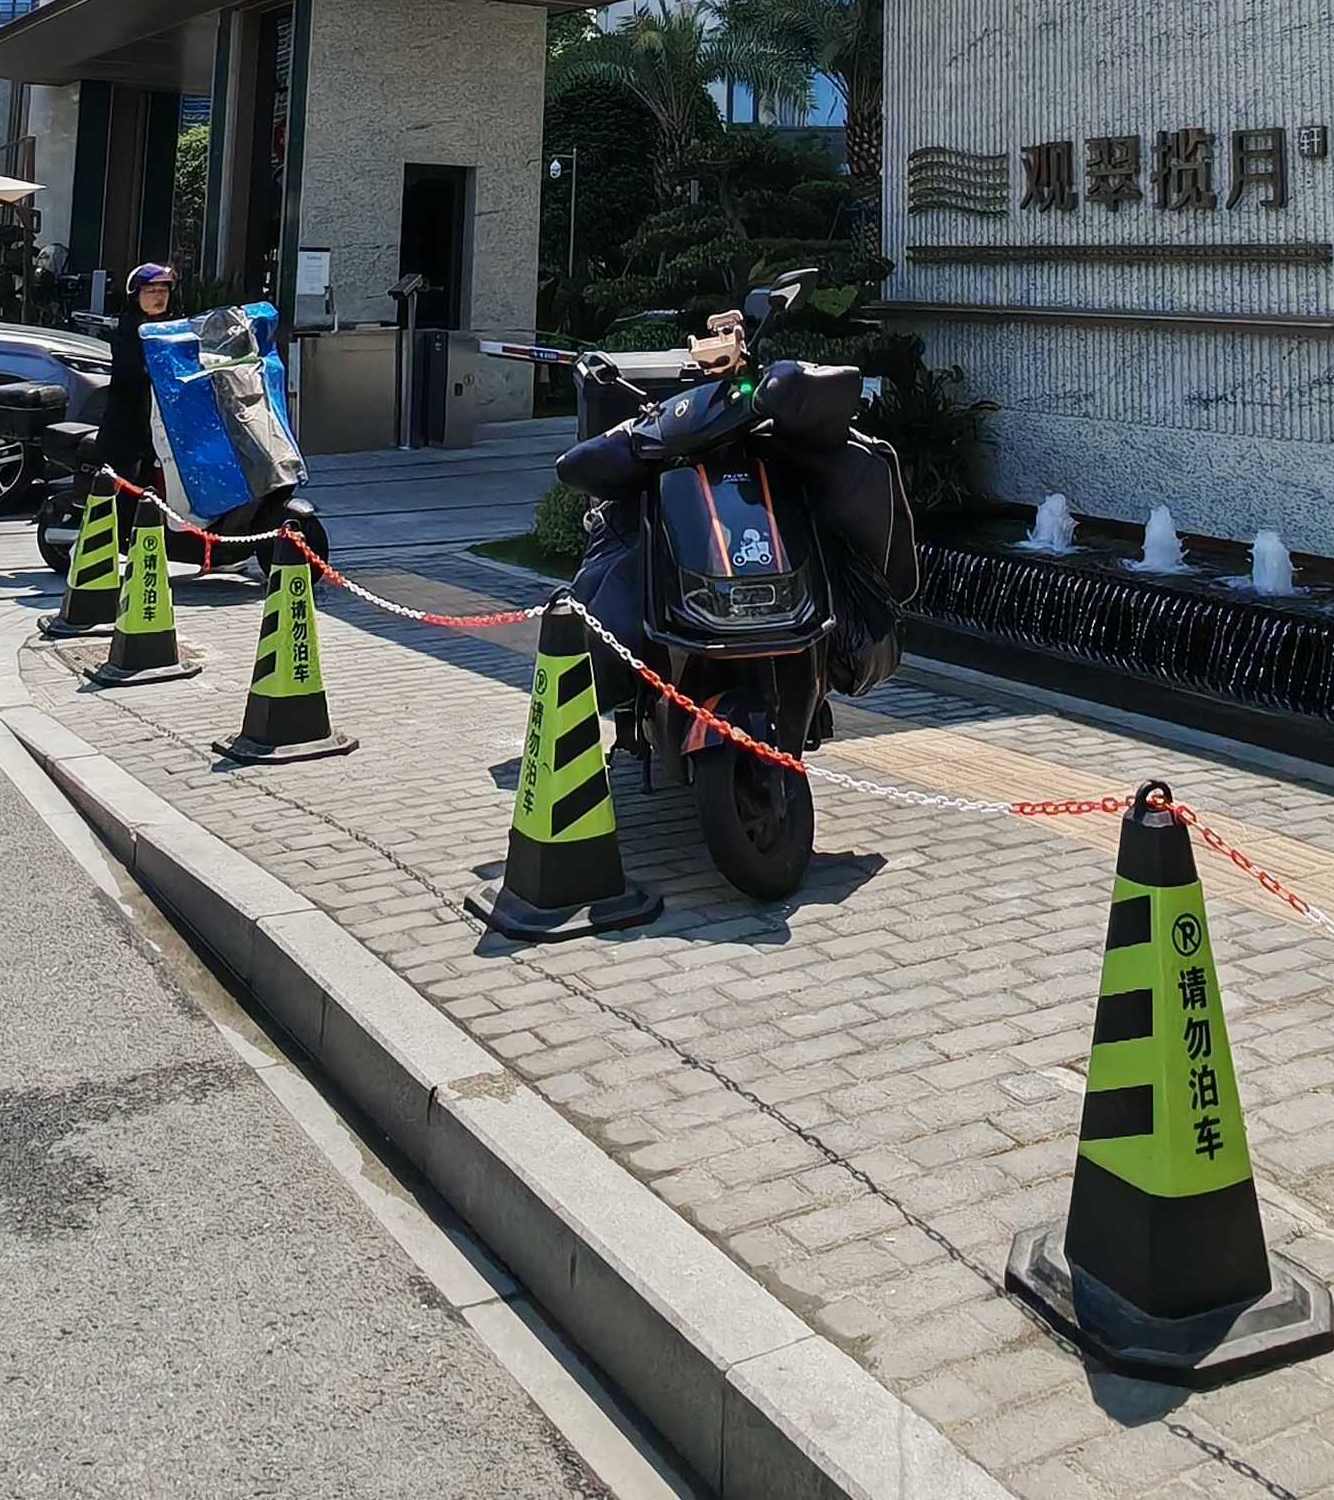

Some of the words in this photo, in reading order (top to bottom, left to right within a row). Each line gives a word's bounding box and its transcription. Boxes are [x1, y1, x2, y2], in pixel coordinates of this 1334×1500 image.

[1019, 126, 1288, 212] 观翠揽月
[142, 554, 158, 622] 请勿泊车
[290, 599, 310, 683] 请勿泊车
[523, 700, 545, 816] 请勿泊车
[1177, 965, 1224, 1161] 请勿泊车
